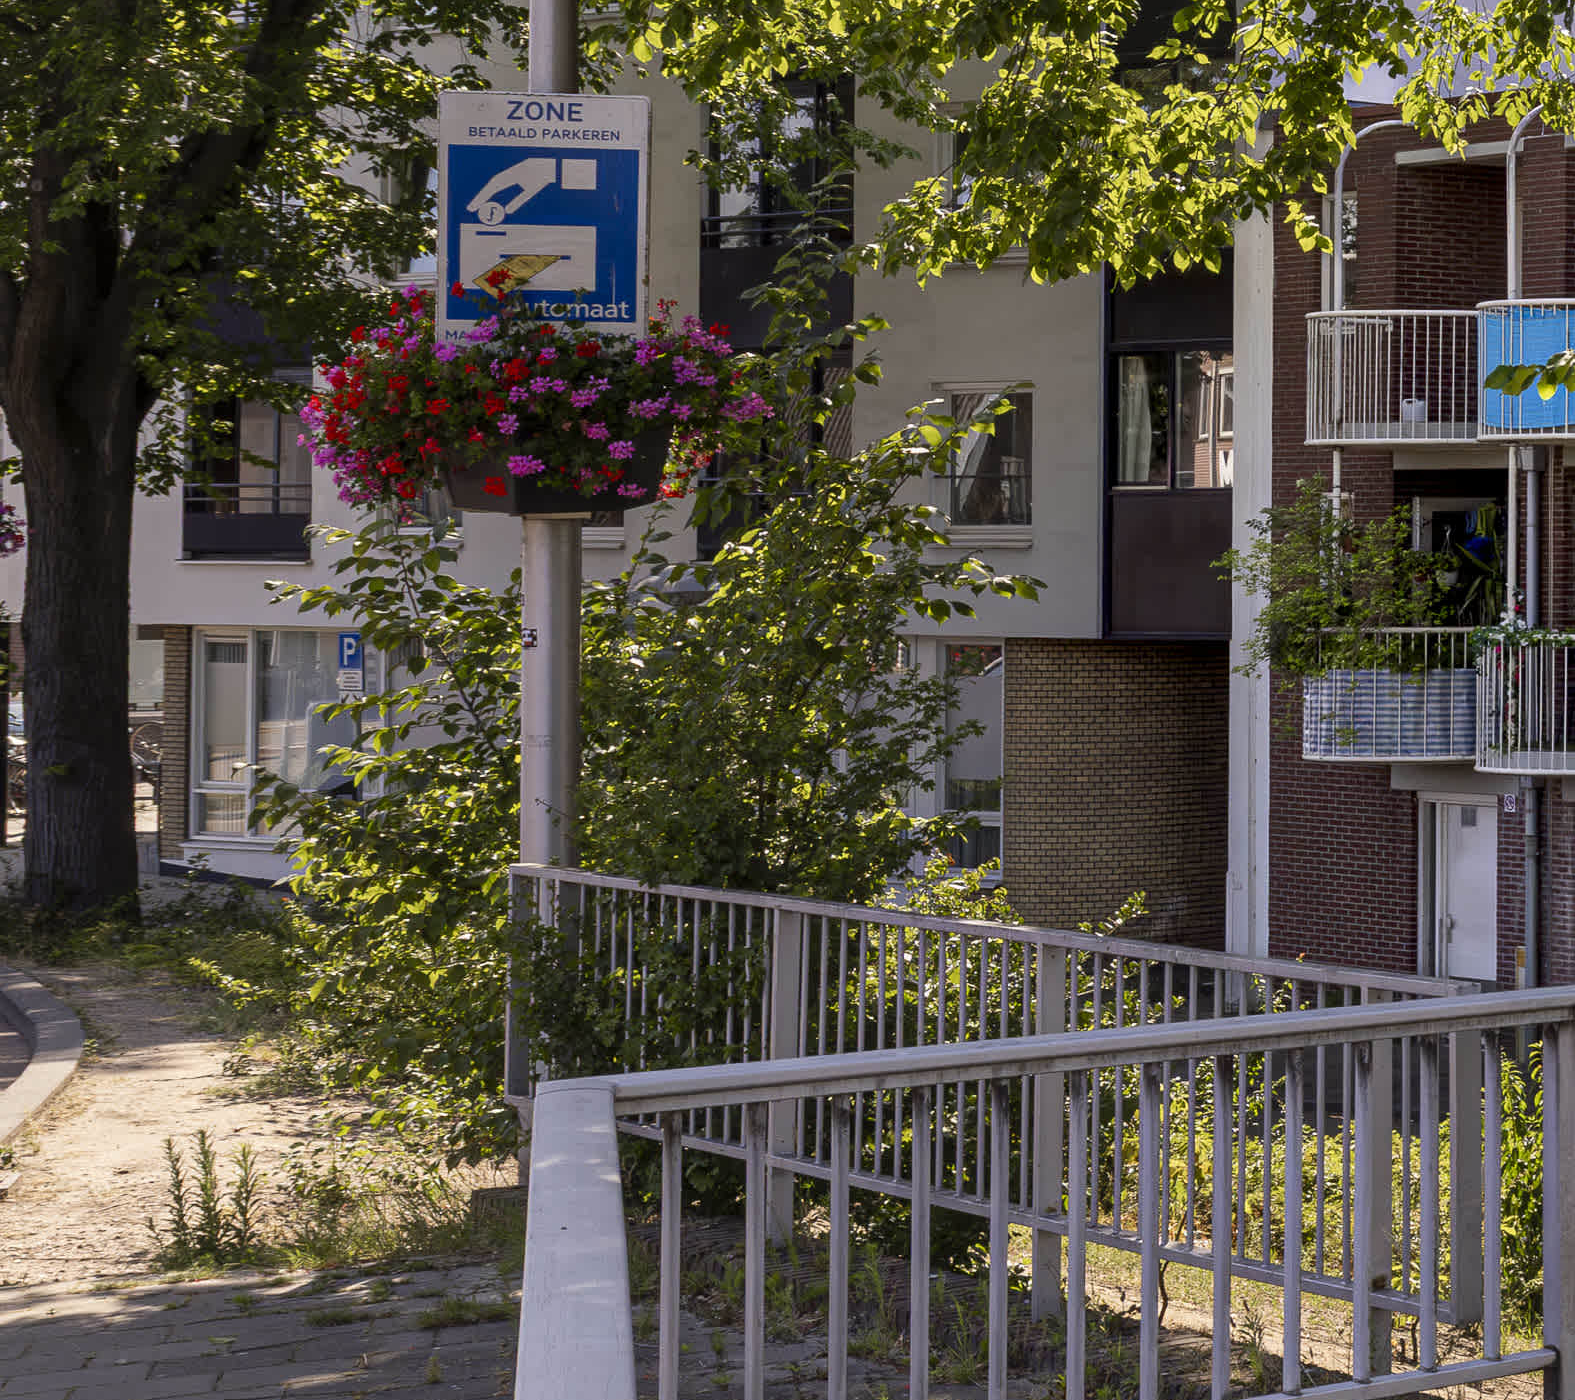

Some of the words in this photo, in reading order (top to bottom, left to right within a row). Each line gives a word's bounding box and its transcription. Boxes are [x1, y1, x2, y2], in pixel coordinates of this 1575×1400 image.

[506, 100, 584, 122] ZONE
[468, 126, 537, 139] BETAALD
[542, 128, 621, 141] PARKEREN
[343, 637, 356, 666] P
